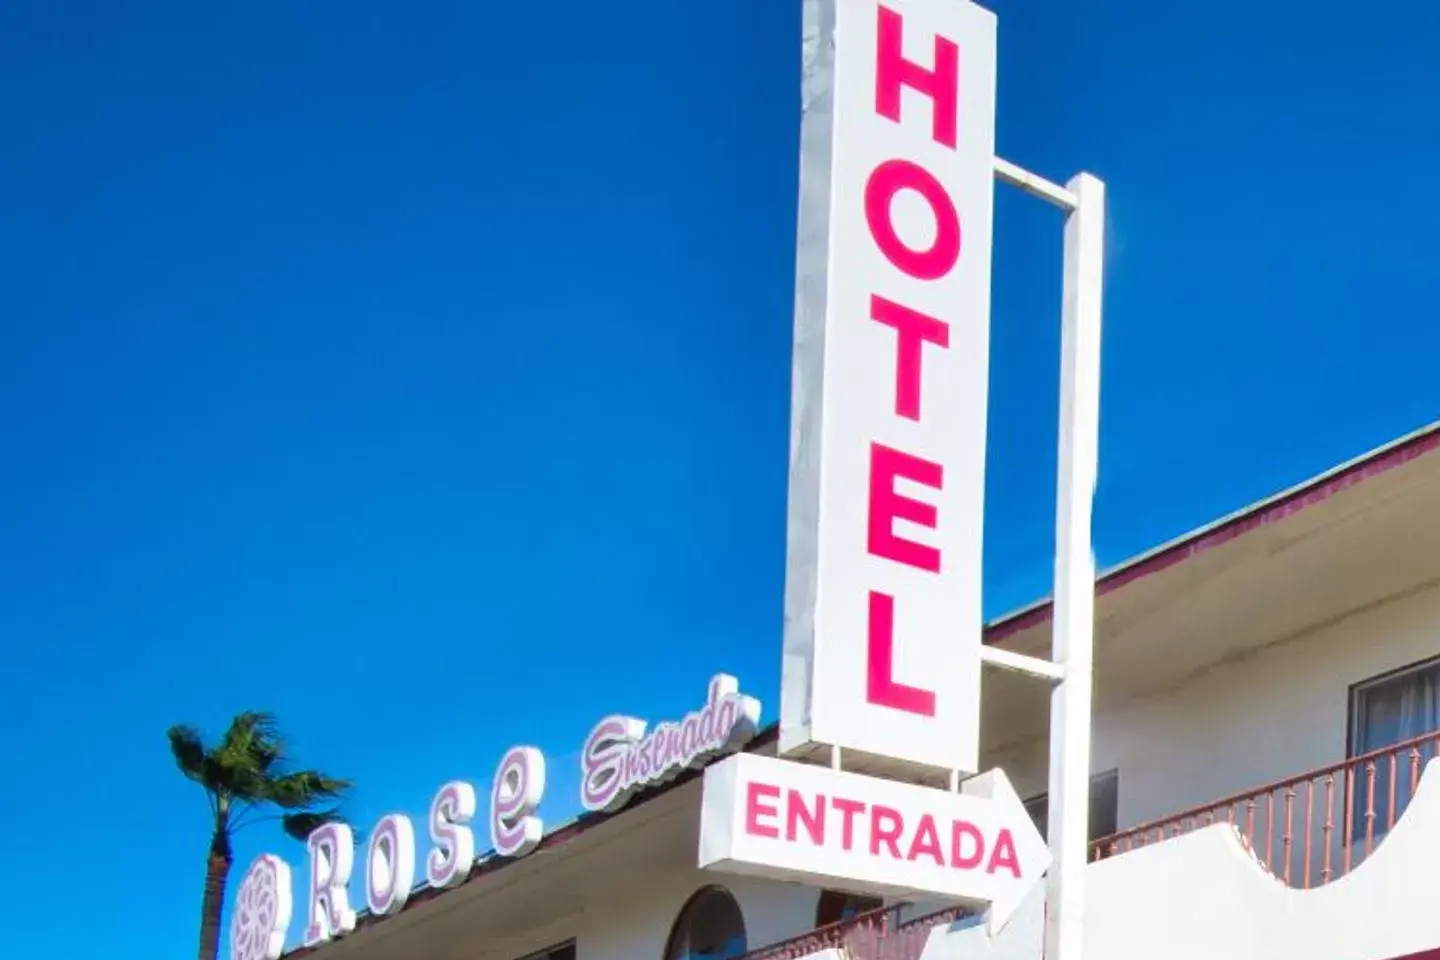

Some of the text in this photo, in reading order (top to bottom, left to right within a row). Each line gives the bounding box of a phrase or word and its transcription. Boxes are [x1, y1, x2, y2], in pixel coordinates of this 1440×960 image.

[864, 4, 961, 717] HOTEL
[582, 674, 754, 809] Ensenada
[746, 783, 1021, 877] ENTRADA
